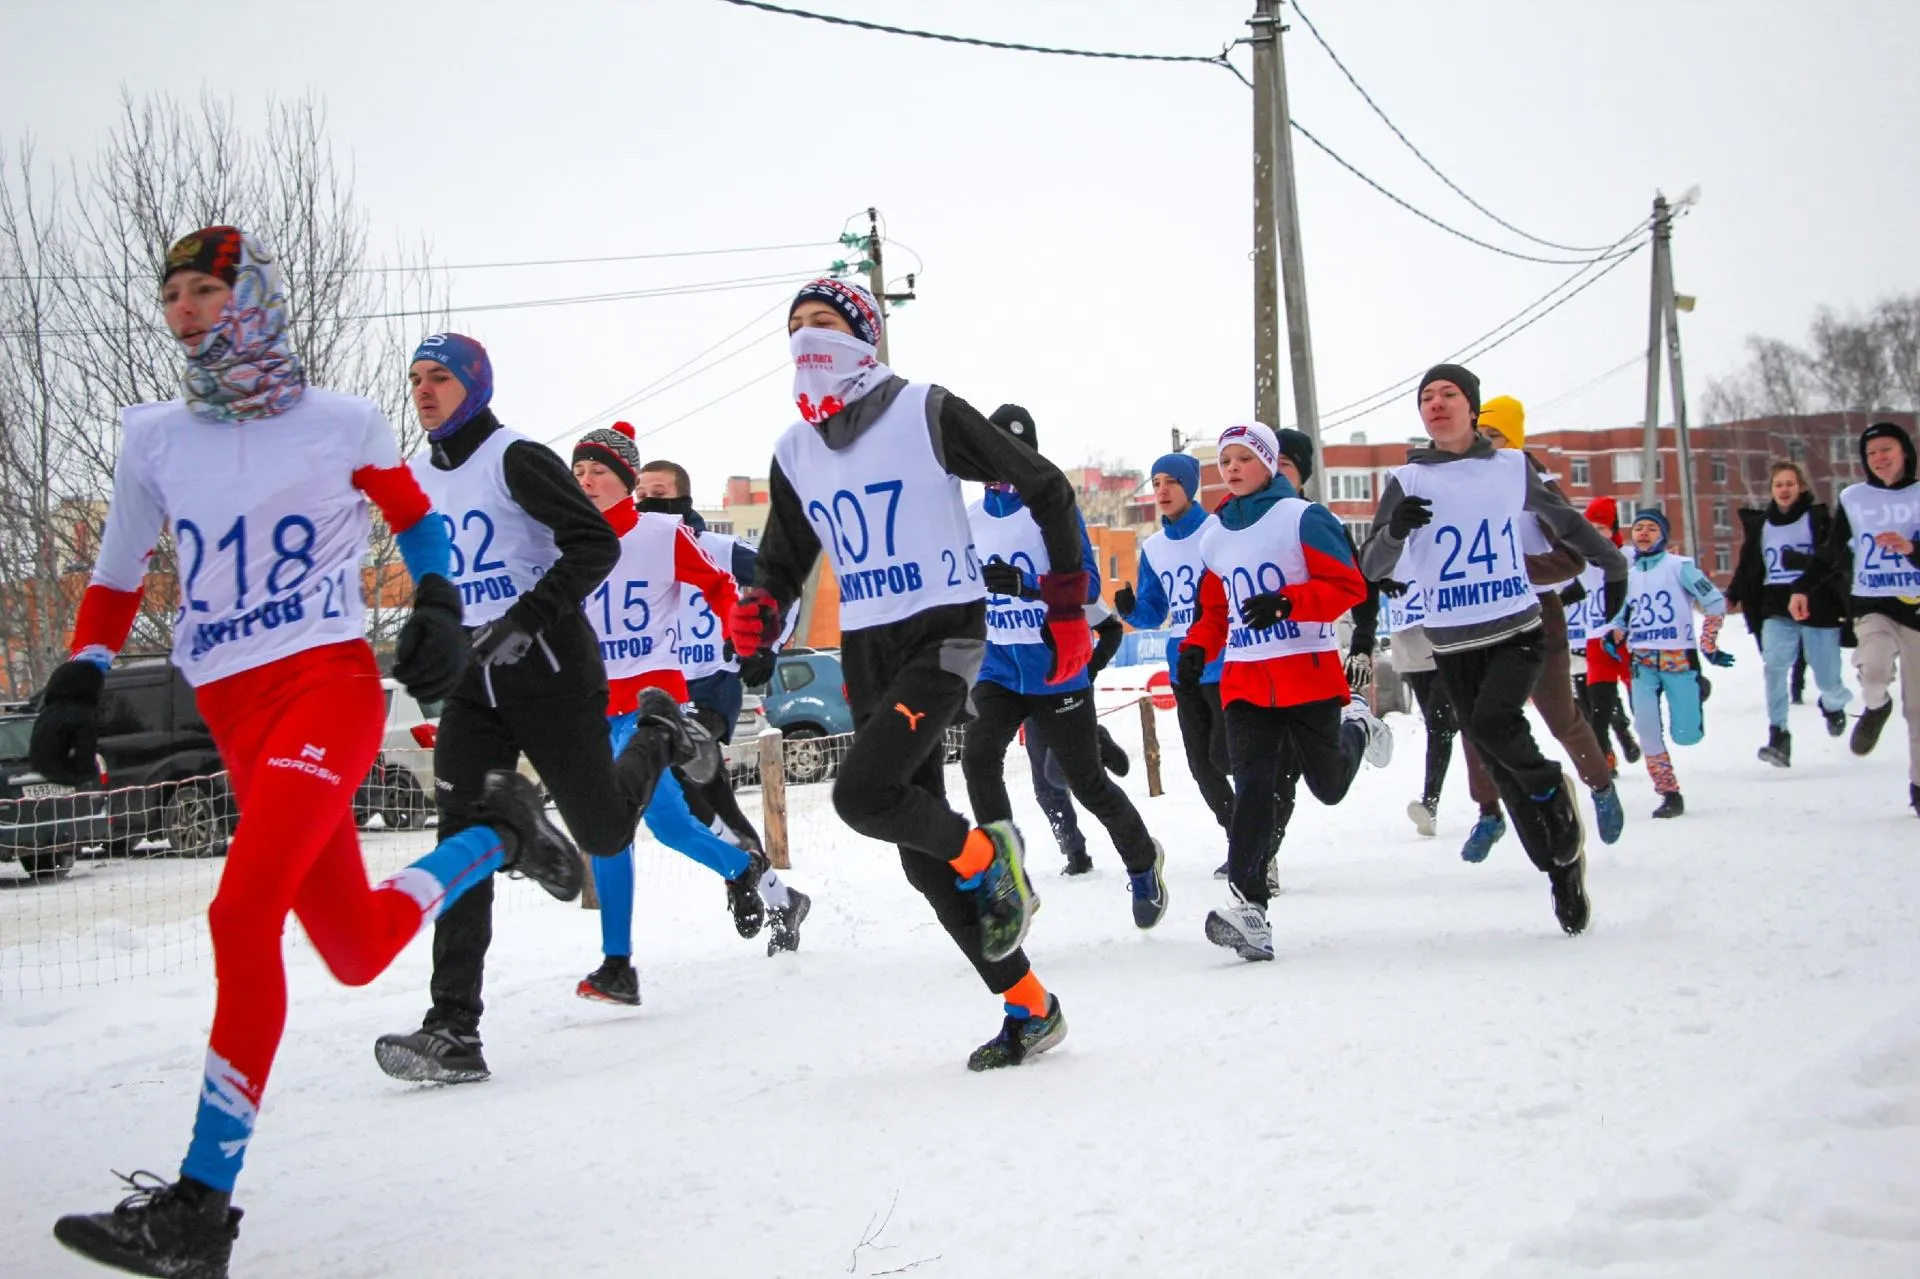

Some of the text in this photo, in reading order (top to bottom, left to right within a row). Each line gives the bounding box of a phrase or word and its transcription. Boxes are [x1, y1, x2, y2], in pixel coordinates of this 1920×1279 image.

[176, 514, 315, 612] 218
[1435, 516, 1518, 581] 241
[455, 574, 518, 606] ТРОВ
[1161, 565, 1198, 607] 23
[1436, 575, 1523, 612] ДМИТРОВ
[588, 580, 649, 634] 15
[1630, 590, 1675, 627] 233
[601, 636, 653, 661] ИТРОВ
[679, 644, 715, 665] ТРОВ
[267, 757, 341, 786] NORDSKI
